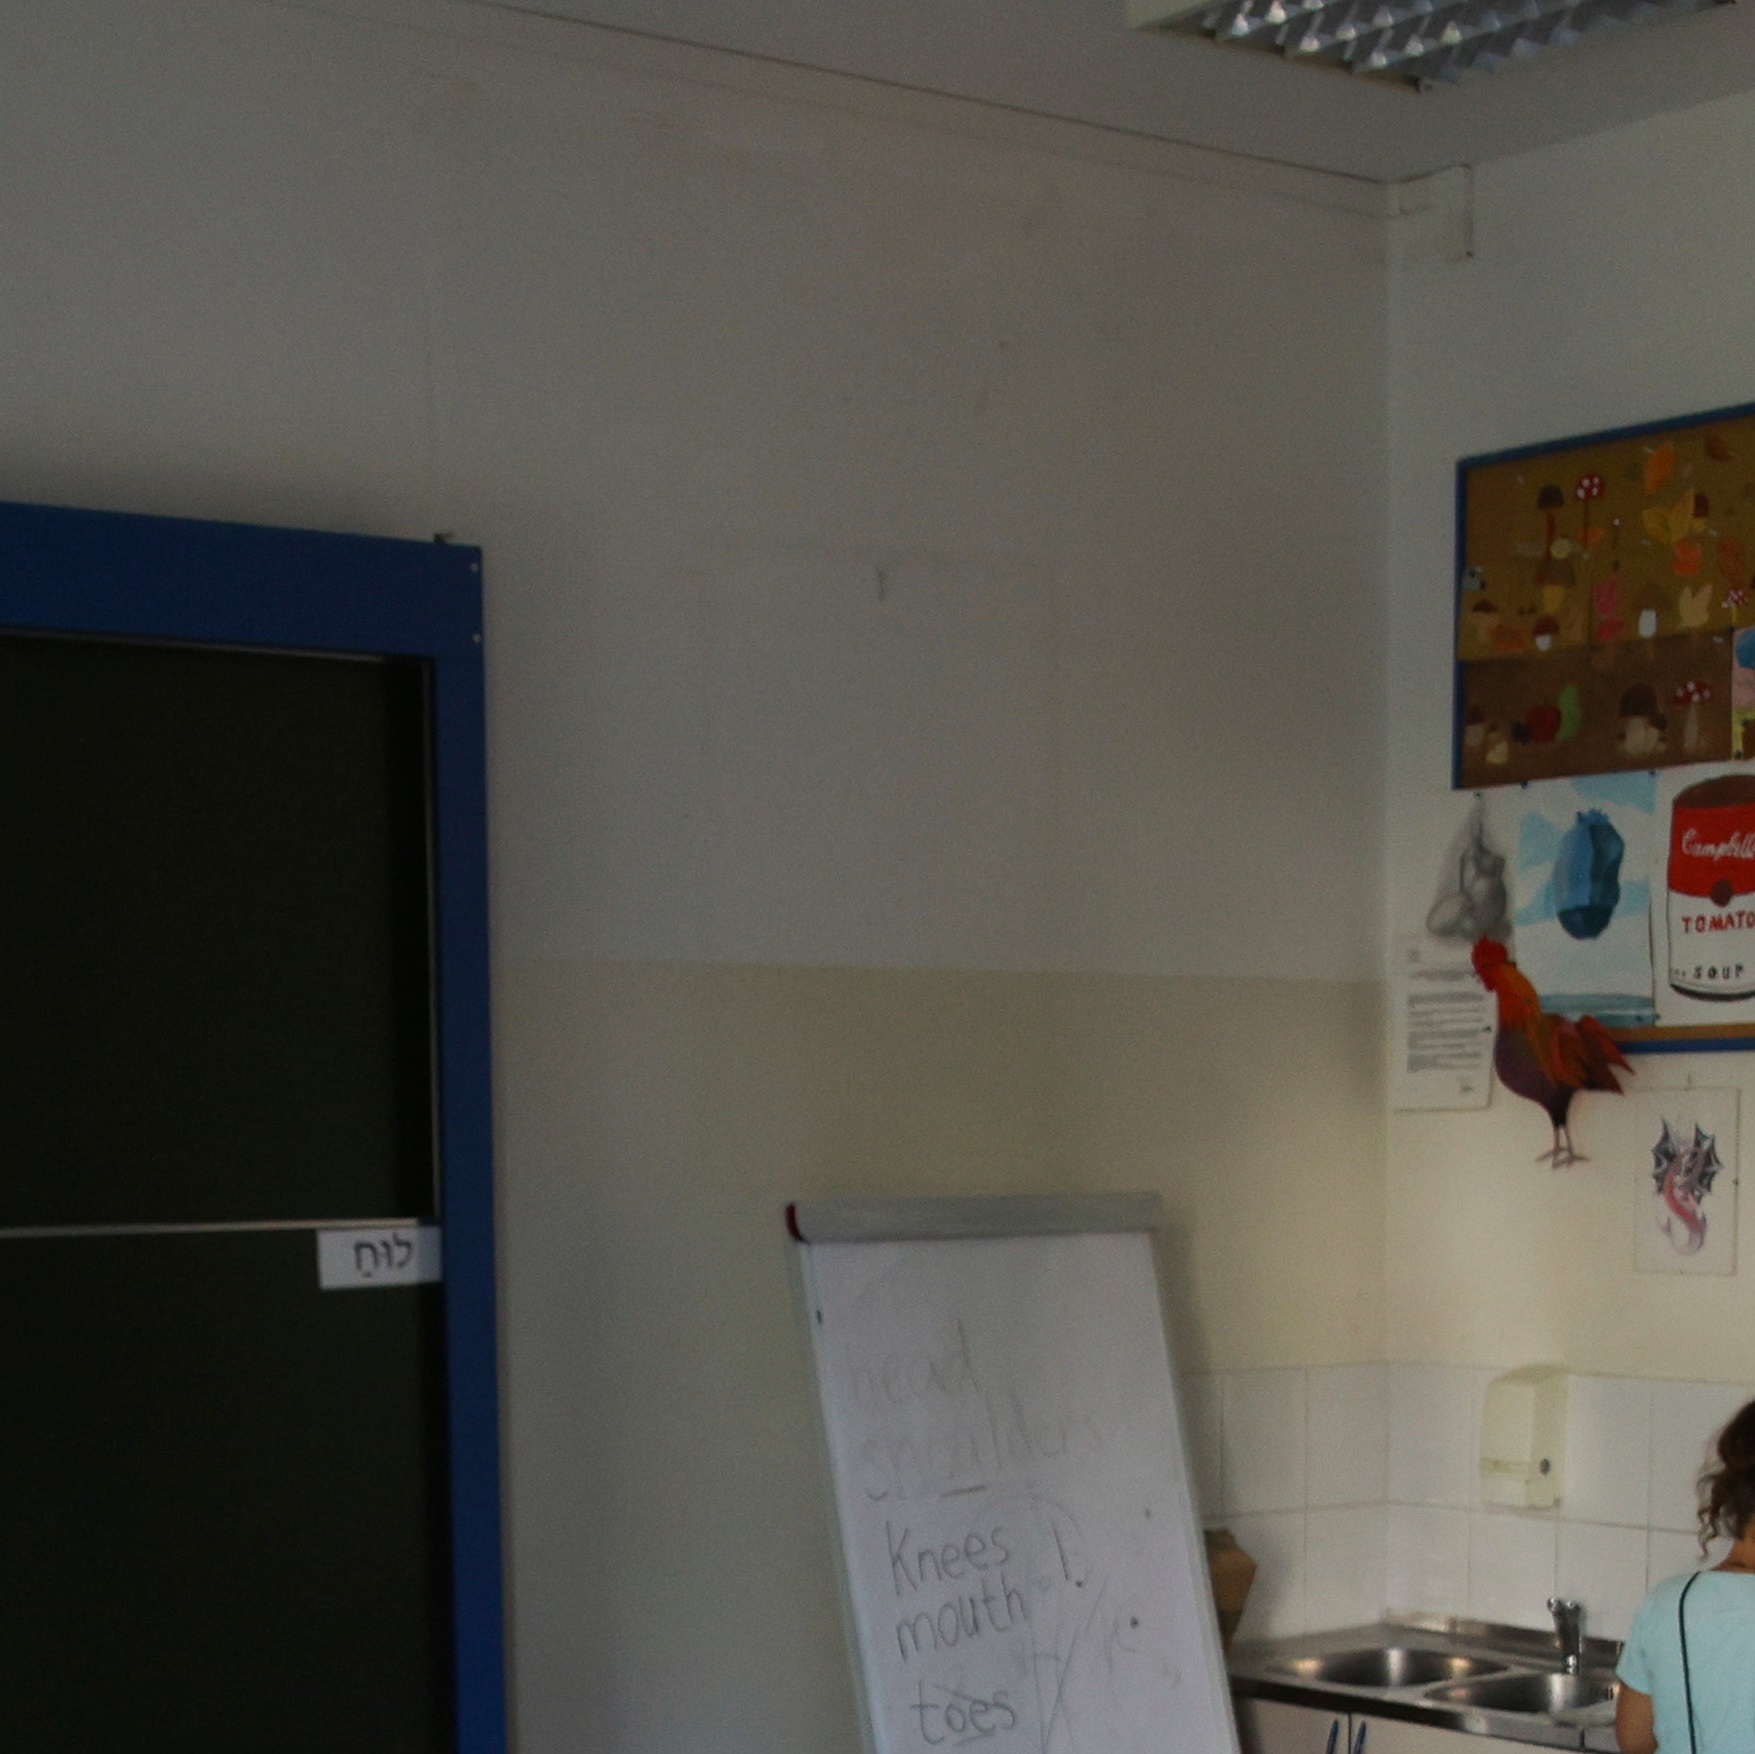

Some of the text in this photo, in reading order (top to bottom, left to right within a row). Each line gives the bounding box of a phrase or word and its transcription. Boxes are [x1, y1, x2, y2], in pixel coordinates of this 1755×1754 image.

[1692, 963, 1745, 981] SOUP
[895, 1571, 1029, 1662] mouth
[909, 1680, 1021, 1745] toes
